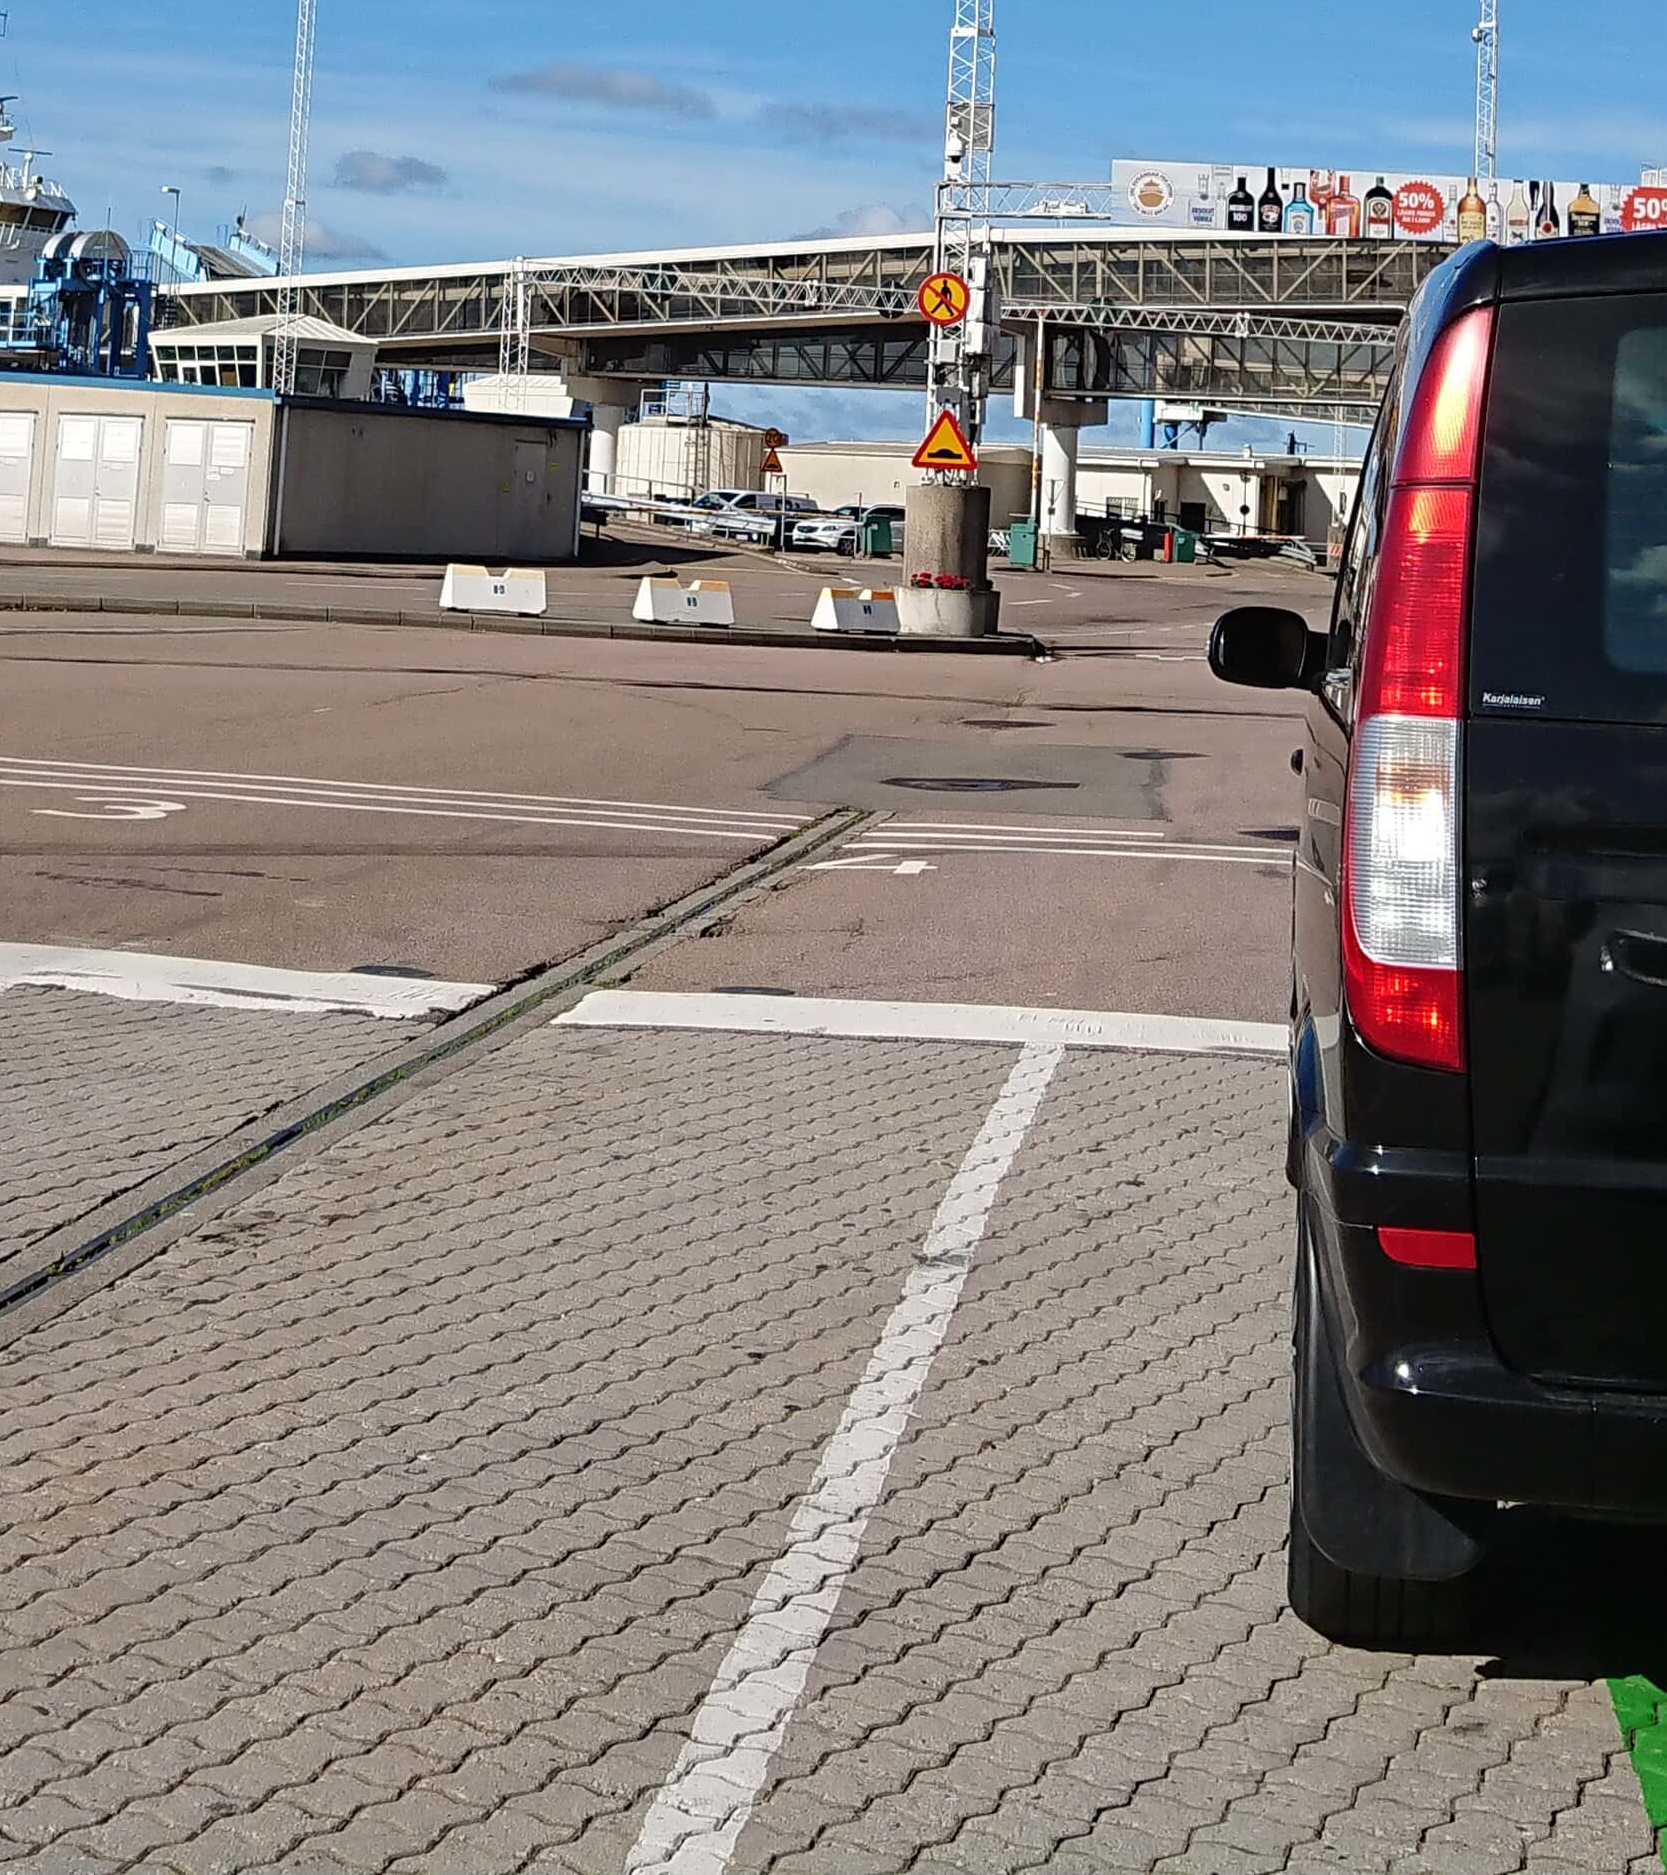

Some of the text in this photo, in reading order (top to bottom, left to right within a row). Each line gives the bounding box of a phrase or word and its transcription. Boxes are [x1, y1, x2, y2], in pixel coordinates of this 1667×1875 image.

[1398, 192, 1435, 209] 50%
[1232, 212, 1248, 223] 100
[1482, 692, 1542, 706] Karjalaisen
